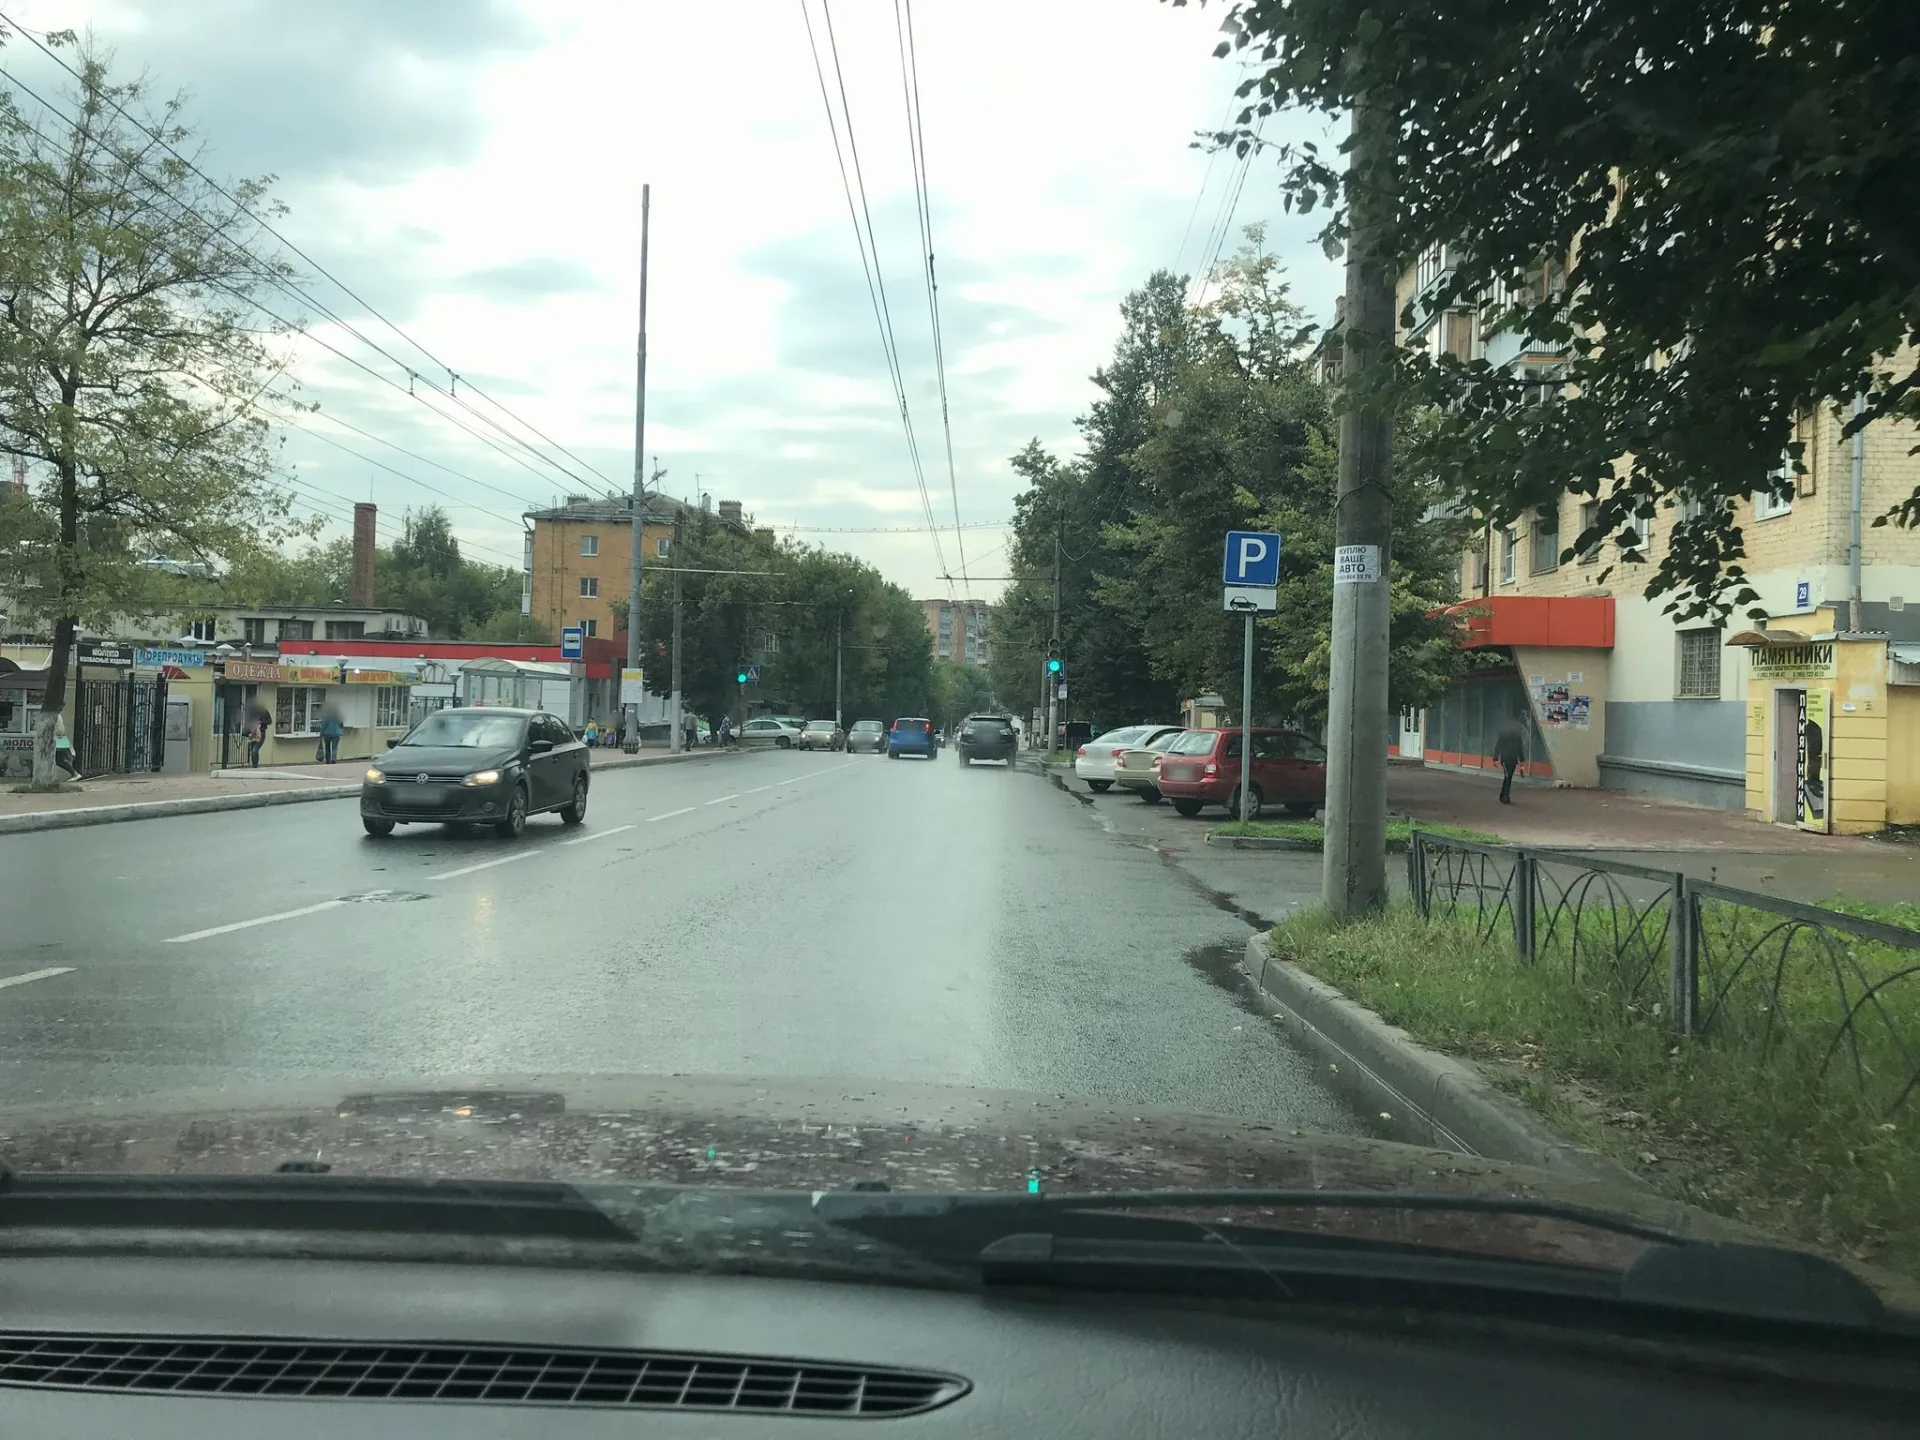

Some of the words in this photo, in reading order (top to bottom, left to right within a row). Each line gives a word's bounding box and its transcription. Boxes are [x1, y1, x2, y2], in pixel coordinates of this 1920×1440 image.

[1339, 546, 1367, 554] КУПЛЮ
[1239, 538, 1267, 577] P
[1340, 555, 1365, 563] ВАШЕ
[1339, 563, 1366, 574] АВТО
[1799, 586, 1807, 600] 29
[140, 652, 201, 664] МОРЕПРОДУКТЫ
[1751, 645, 1833, 666] ПАМЯТНИКИ
[232, 664, 281, 679] ОДЕЖДА
[1797, 694, 1806, 818] ПАМЯТНИКИ
